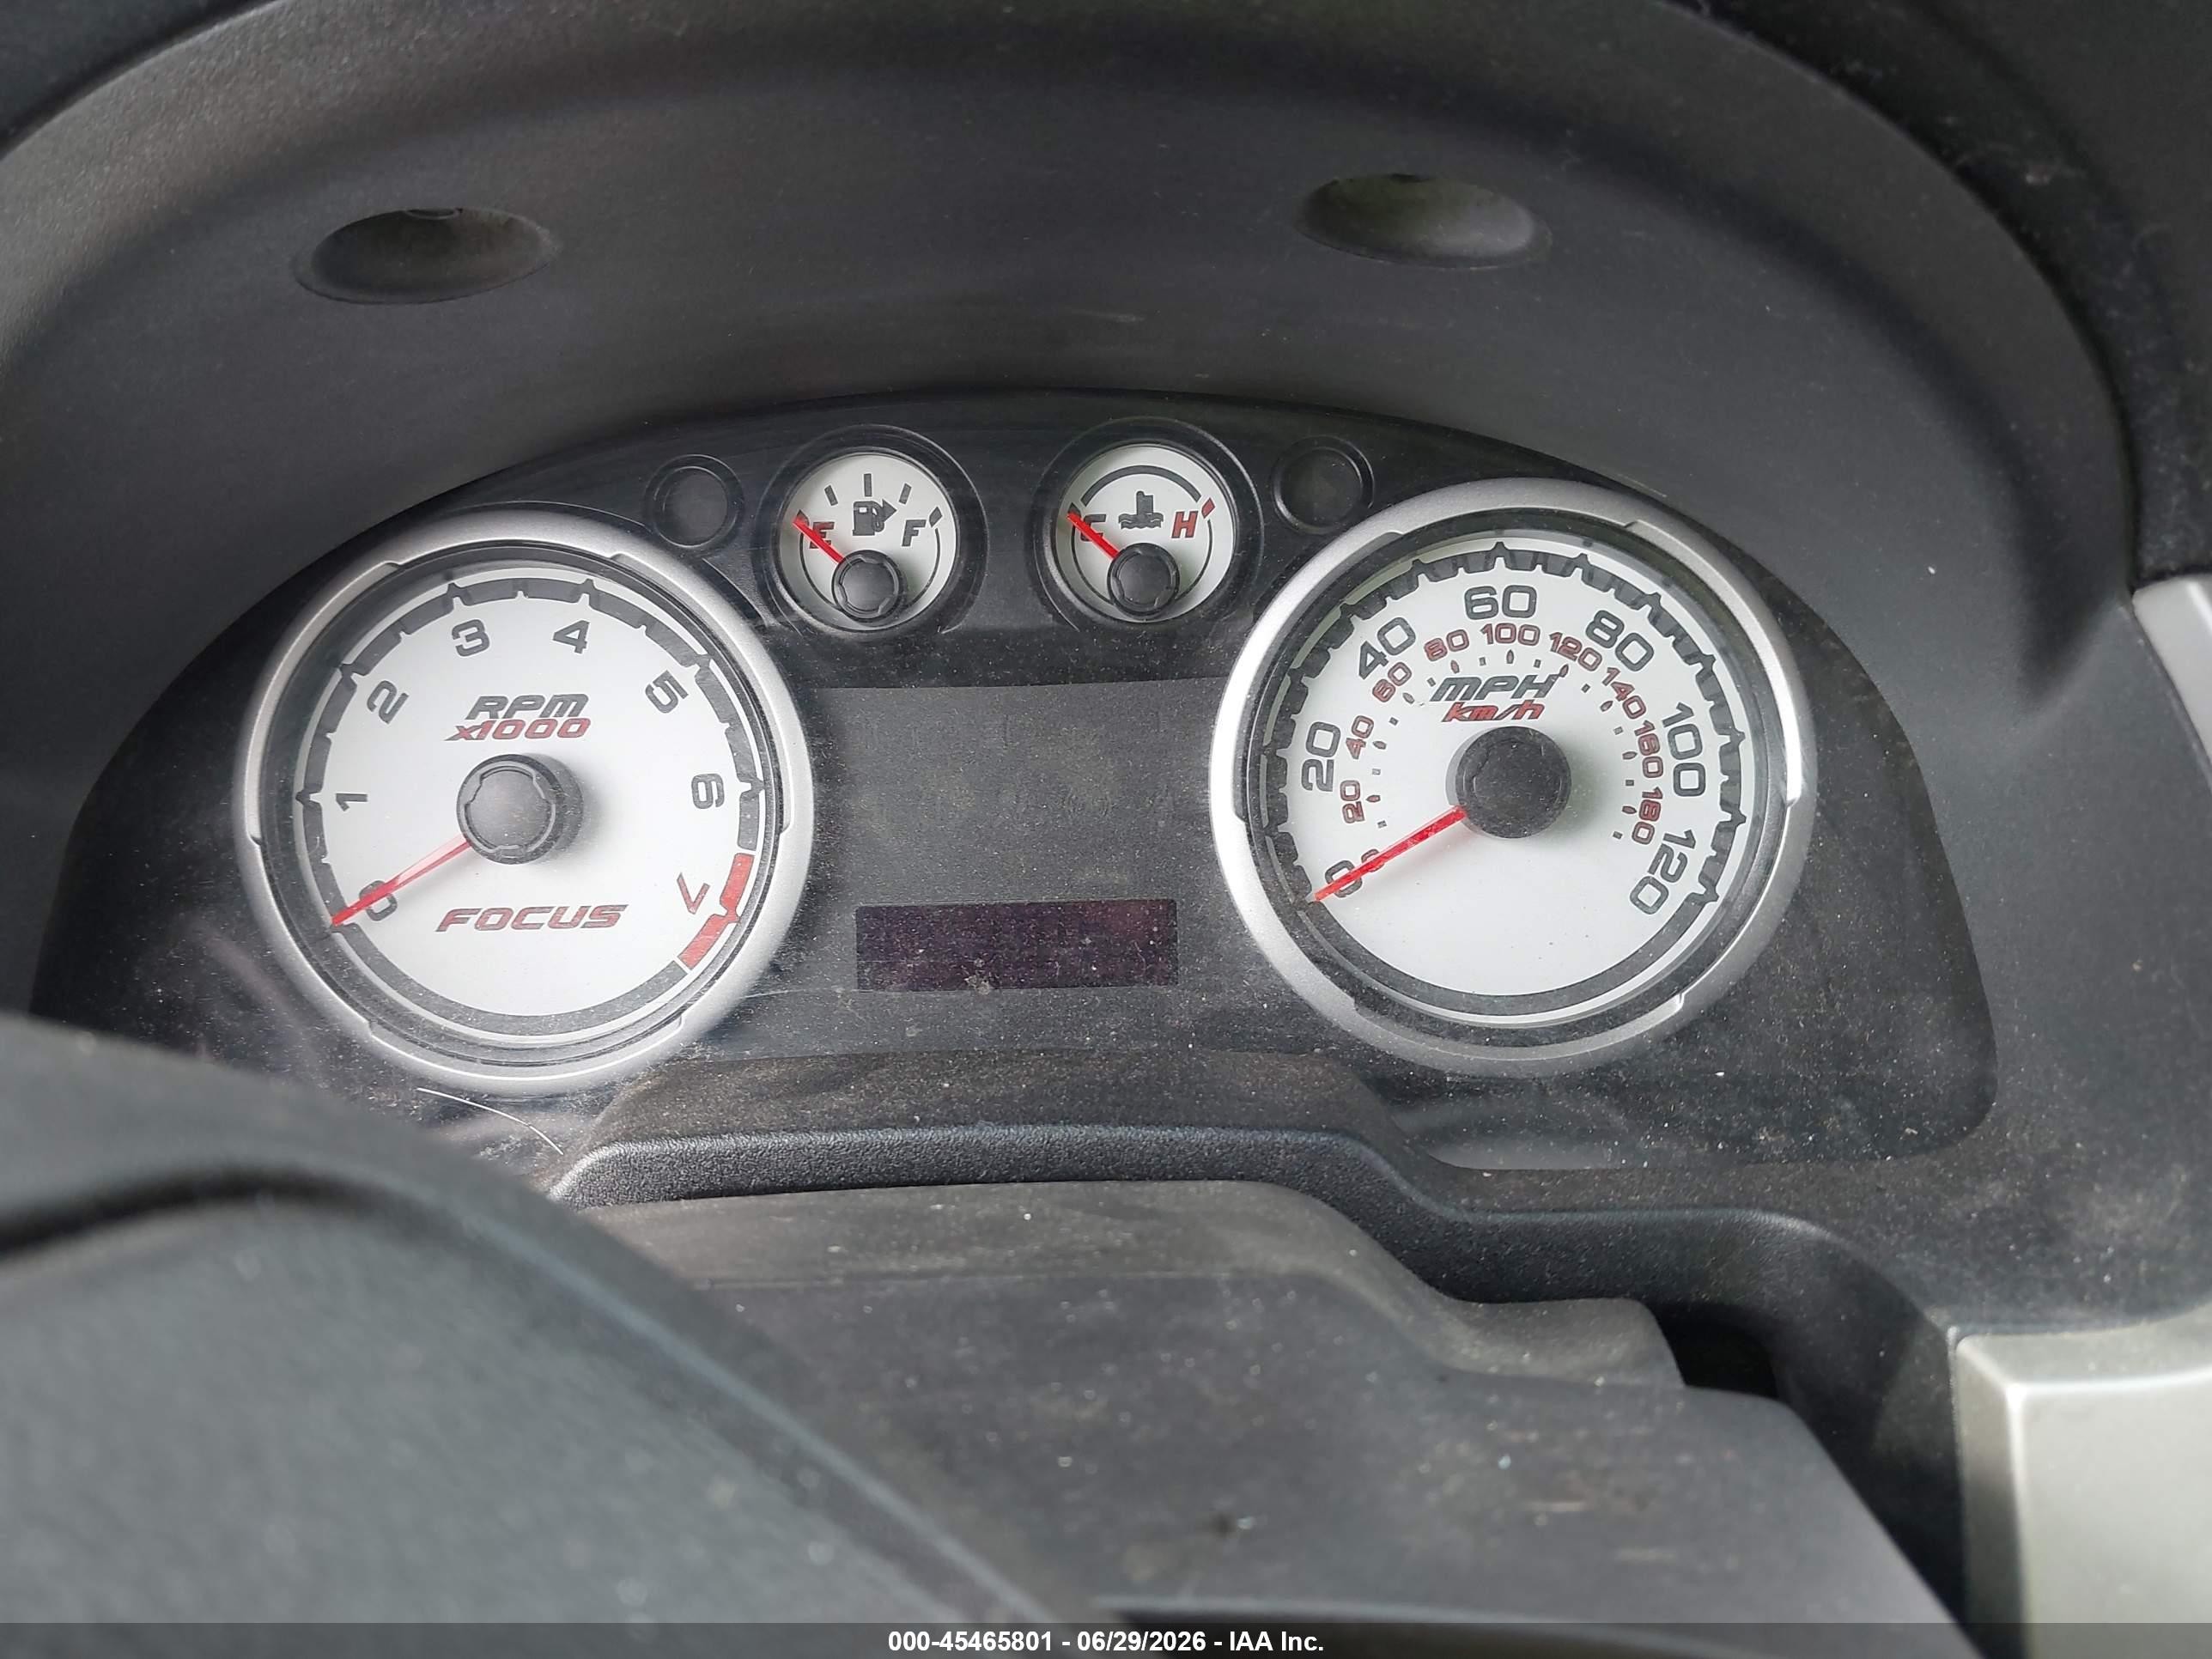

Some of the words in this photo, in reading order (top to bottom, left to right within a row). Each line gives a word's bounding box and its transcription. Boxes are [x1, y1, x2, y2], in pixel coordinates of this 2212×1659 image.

[808, 521, 834, 550] E
[901, 519, 927, 546] F
[1170, 510, 1197, 539] H
[1464, 585, 1537, 619] 60
[452, 618, 491, 656] 3
[553, 620, 591, 654] 4
[1357, 617, 1417, 680] 40
[1424, 629, 1469, 662] 80
[1480, 623, 1541, 646] 100
[1549, 632, 1602, 672] 120
[1586, 609, 1654, 672] 80
[366, 679, 409, 724] 2
[644, 670, 689, 714] 5
[1371, 660, 1412, 702] 60
[1431, 673, 1555, 702] MPH
[1601, 668, 1647, 720] 140
[465, 694, 588, 720] RPM
[1301, 721, 1341, 792] 20
[1345, 715, 1374, 760] 40
[1634, 720, 1664, 779] 160
[1661, 702, 1706, 798] 100
[337, 792, 369, 811] 1
[690, 774, 725, 809] 6
[1340, 780, 1364, 823] 20
[1632, 787, 1662, 845] 180
[676, 872, 710, 915] 7
[1629, 830, 1698, 915] 120
[357, 880, 398, 922] 0
[436, 904, 628, 933] FOCUS
